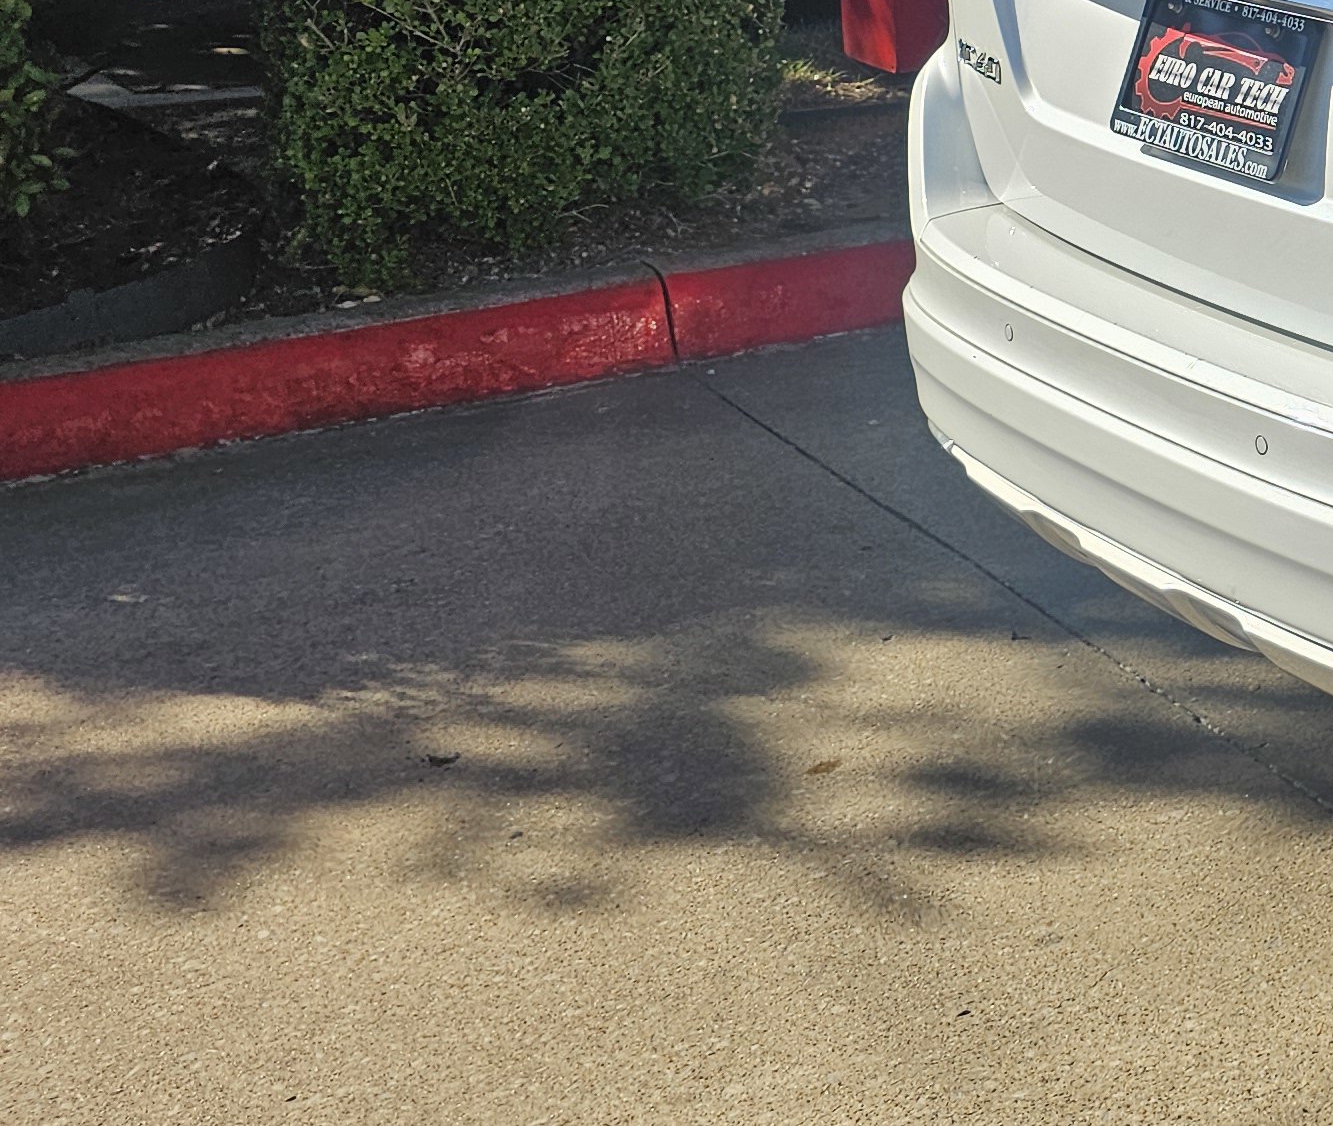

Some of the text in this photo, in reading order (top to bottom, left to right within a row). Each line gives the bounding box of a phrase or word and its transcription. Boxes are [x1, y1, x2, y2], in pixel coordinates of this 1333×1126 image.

[1242, 5, 1306, 32] 817-404-4033
[1149, 54, 1290, 114] EURO CAR TECH
[1183, 91, 1278, 126] european automotive
[1113, 117, 1268, 179] www.ECTAUTOSALES.com
[1179, 113, 1273, 151] 817-404-4033
